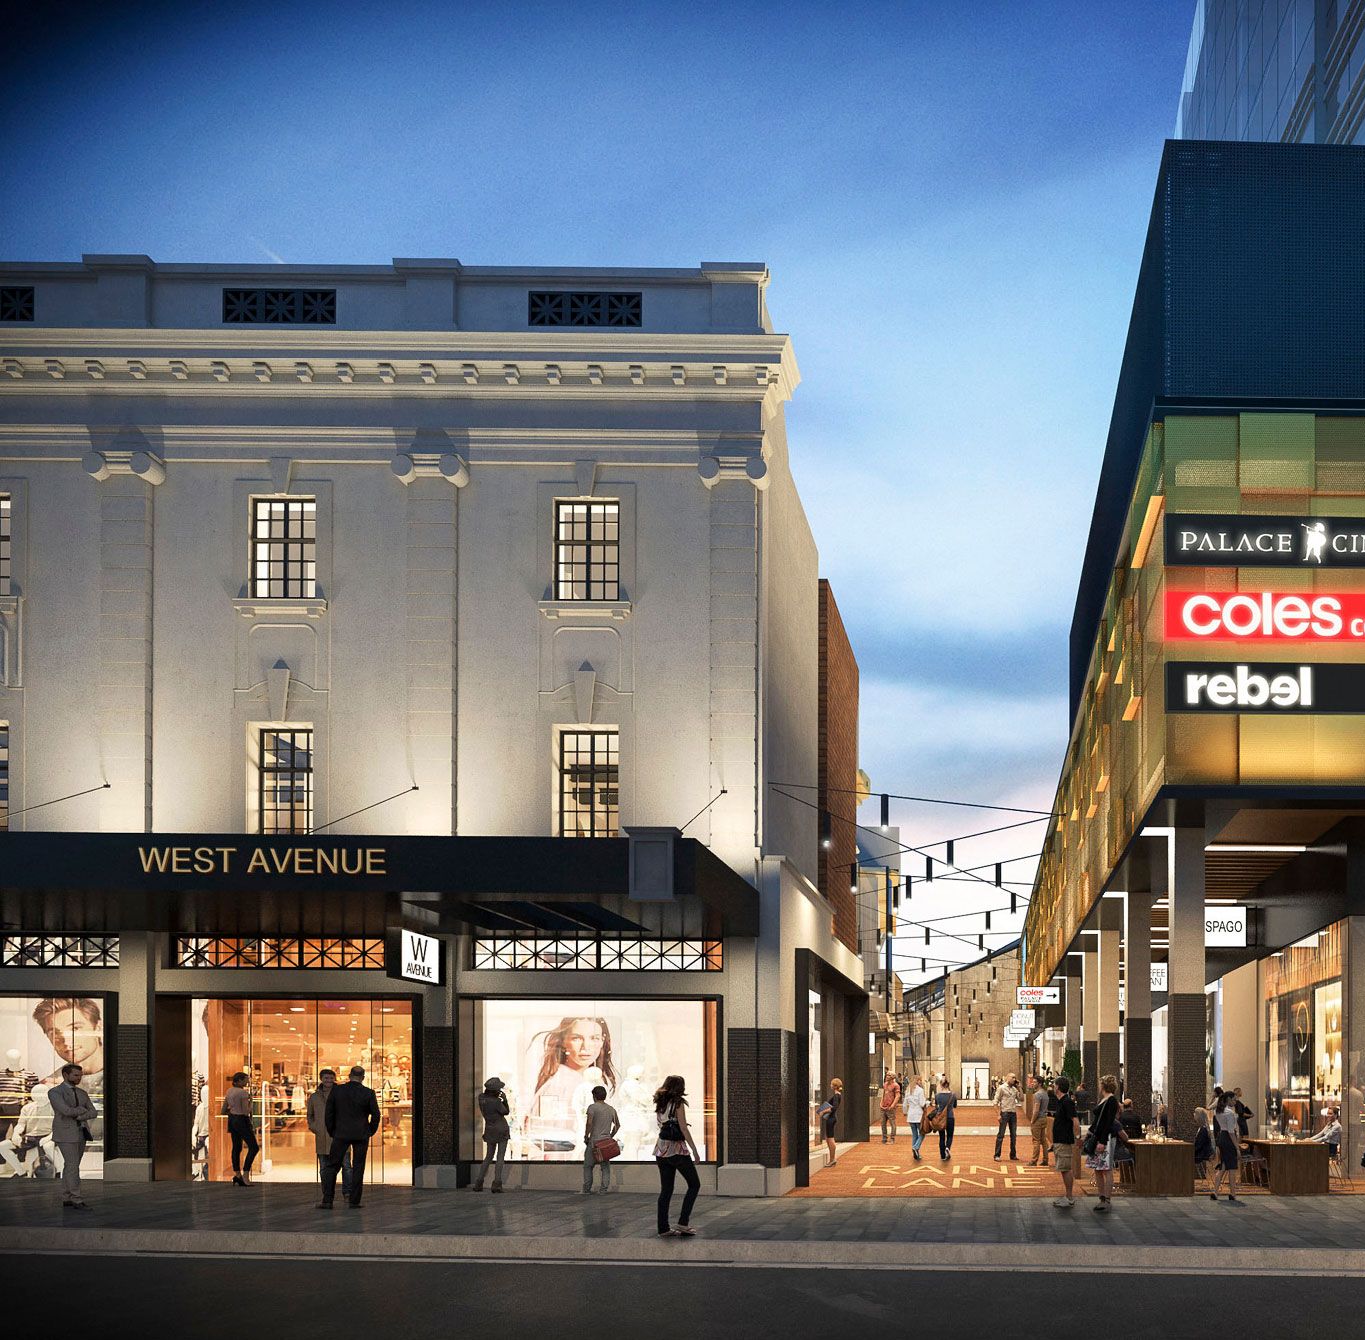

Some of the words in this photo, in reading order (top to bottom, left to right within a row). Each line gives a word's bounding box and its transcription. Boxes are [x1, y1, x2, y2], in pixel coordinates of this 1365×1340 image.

[1180, 531, 1293, 553] PALACE
[1182, 592, 1343, 637] coles
[1185, 665, 1313, 706] rebel
[138, 846, 236, 873] WEST
[246, 847, 387, 874] AVENUE
[1205, 920, 1243, 933] SPAGO
[410, 935, 428, 963] W
[405, 962, 433, 979] AVENUE
[858, 1165, 1055, 1175] RAINE
[861, 1177, 1045, 1189] LANE
